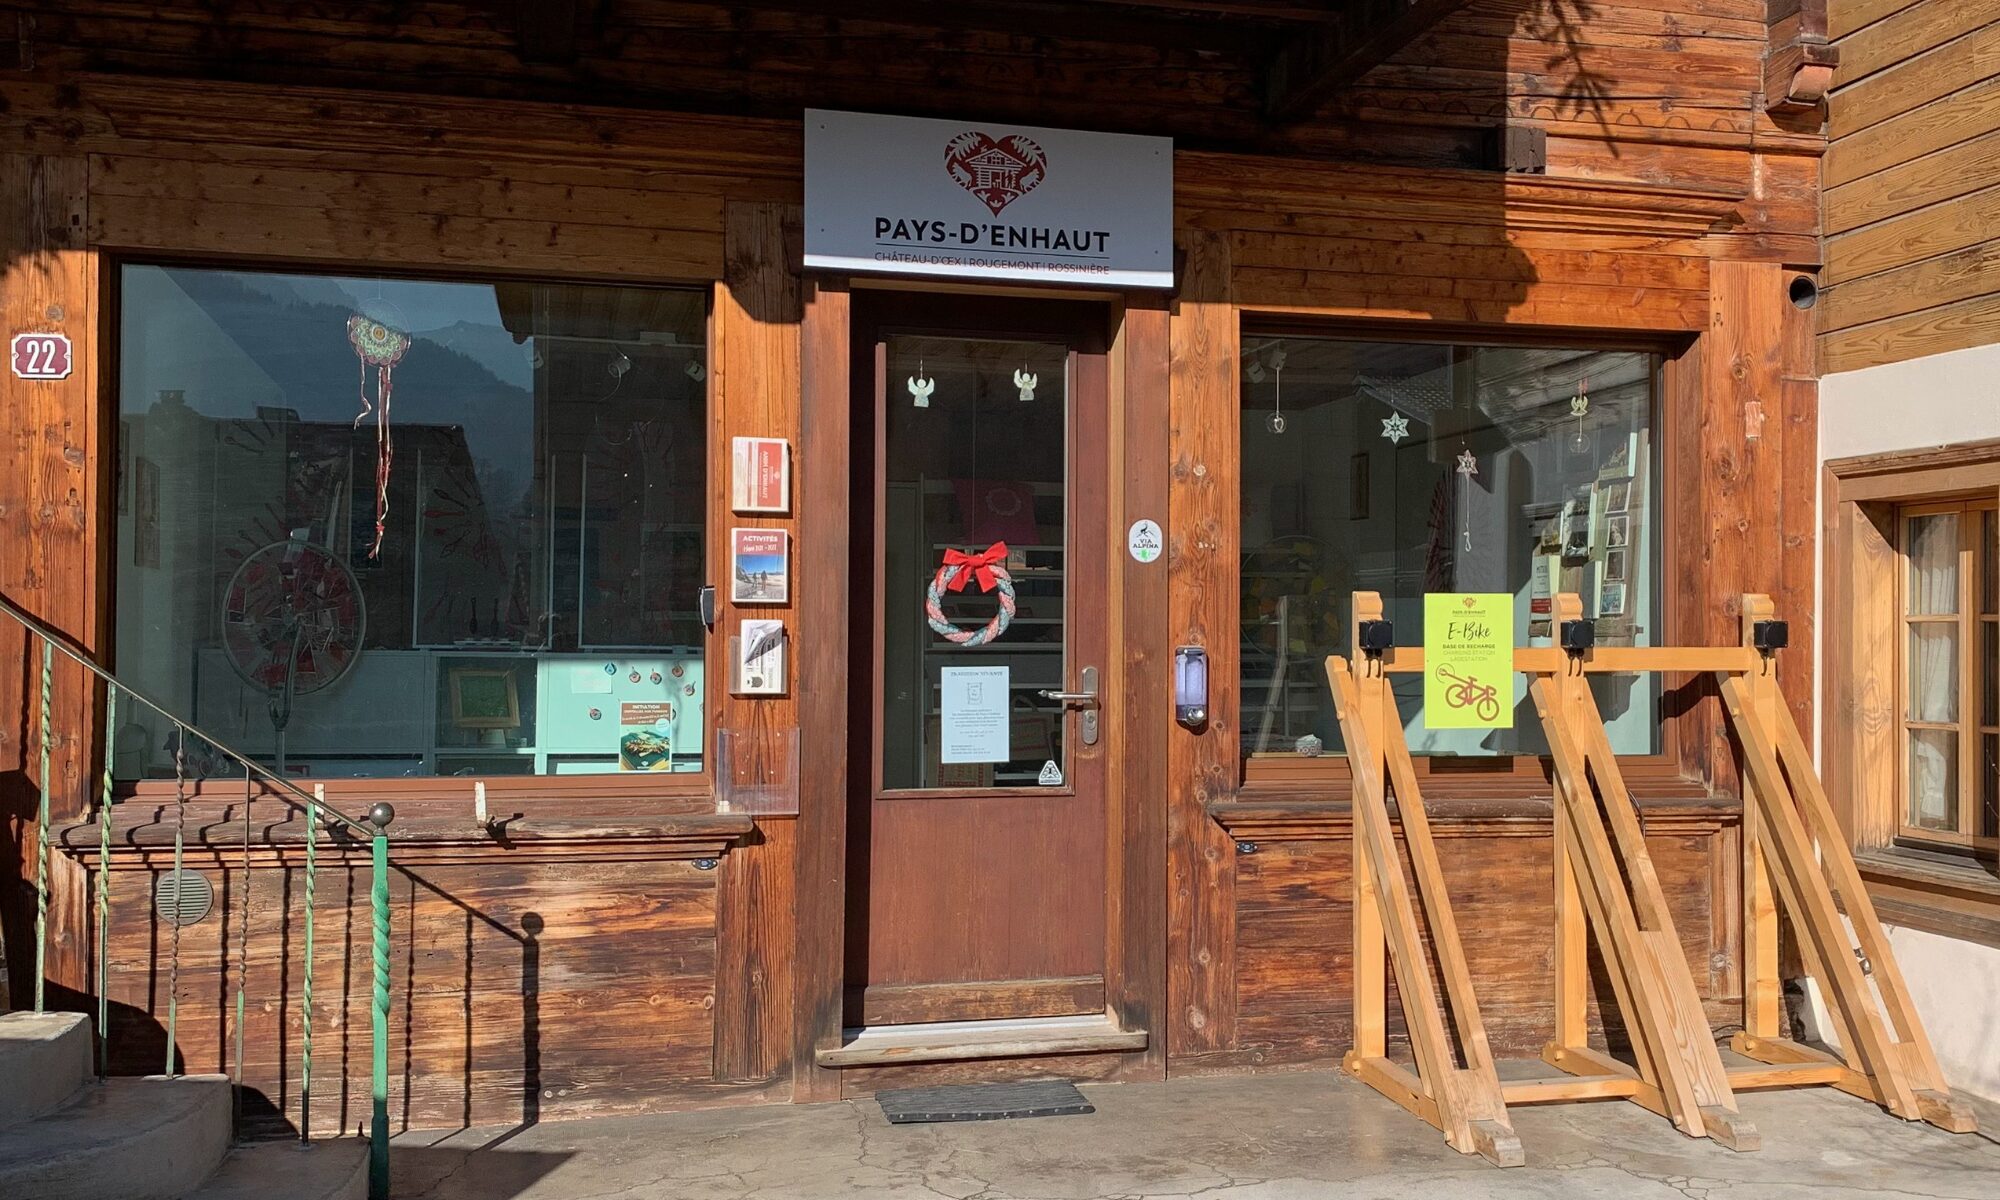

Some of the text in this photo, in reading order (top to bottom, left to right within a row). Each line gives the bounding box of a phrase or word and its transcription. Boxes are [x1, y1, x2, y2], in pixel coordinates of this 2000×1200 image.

[875, 217, 1110, 252] PAYS-D’ENHAUT
[968, 259, 1040, 271] ROUGEMONT
[1047, 262, 1110, 275] ROSSINIÈRE
[26, 340, 56, 373] 22
[1447, 621, 1491, 641] E-Bike
